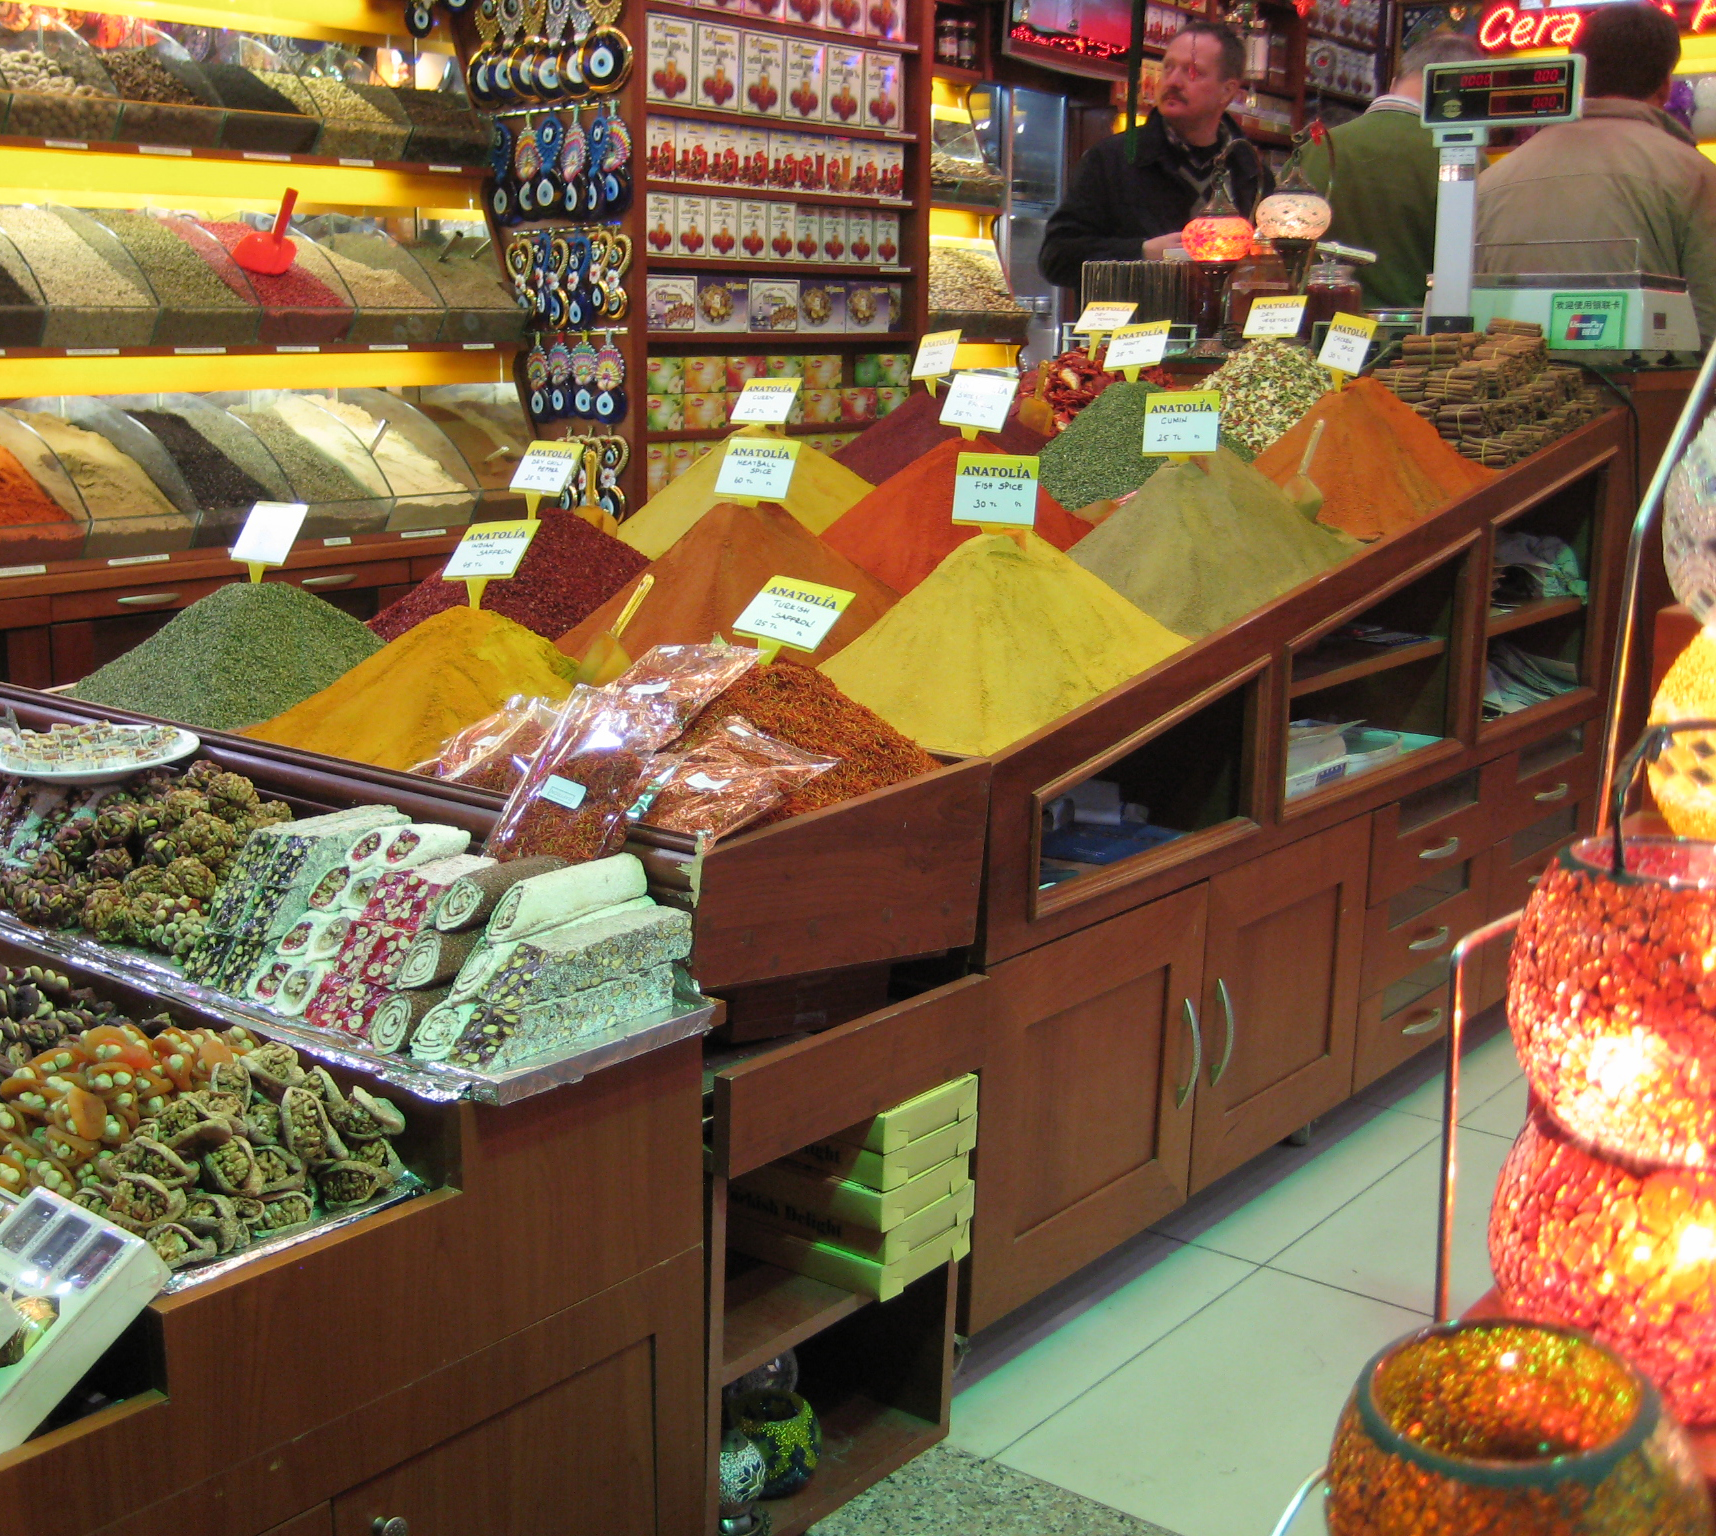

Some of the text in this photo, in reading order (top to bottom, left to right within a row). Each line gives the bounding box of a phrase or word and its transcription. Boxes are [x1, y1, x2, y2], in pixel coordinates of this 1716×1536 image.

[1160, 415, 1188, 425] CUMIN
[736, 460, 776, 468] MEATBALL
[974, 480, 1024, 491] FISH SPICE
[972, 499, 987, 509] 30
[773, 599, 811, 614] TURKISH
[771, 612, 816, 628] SAFFRON
